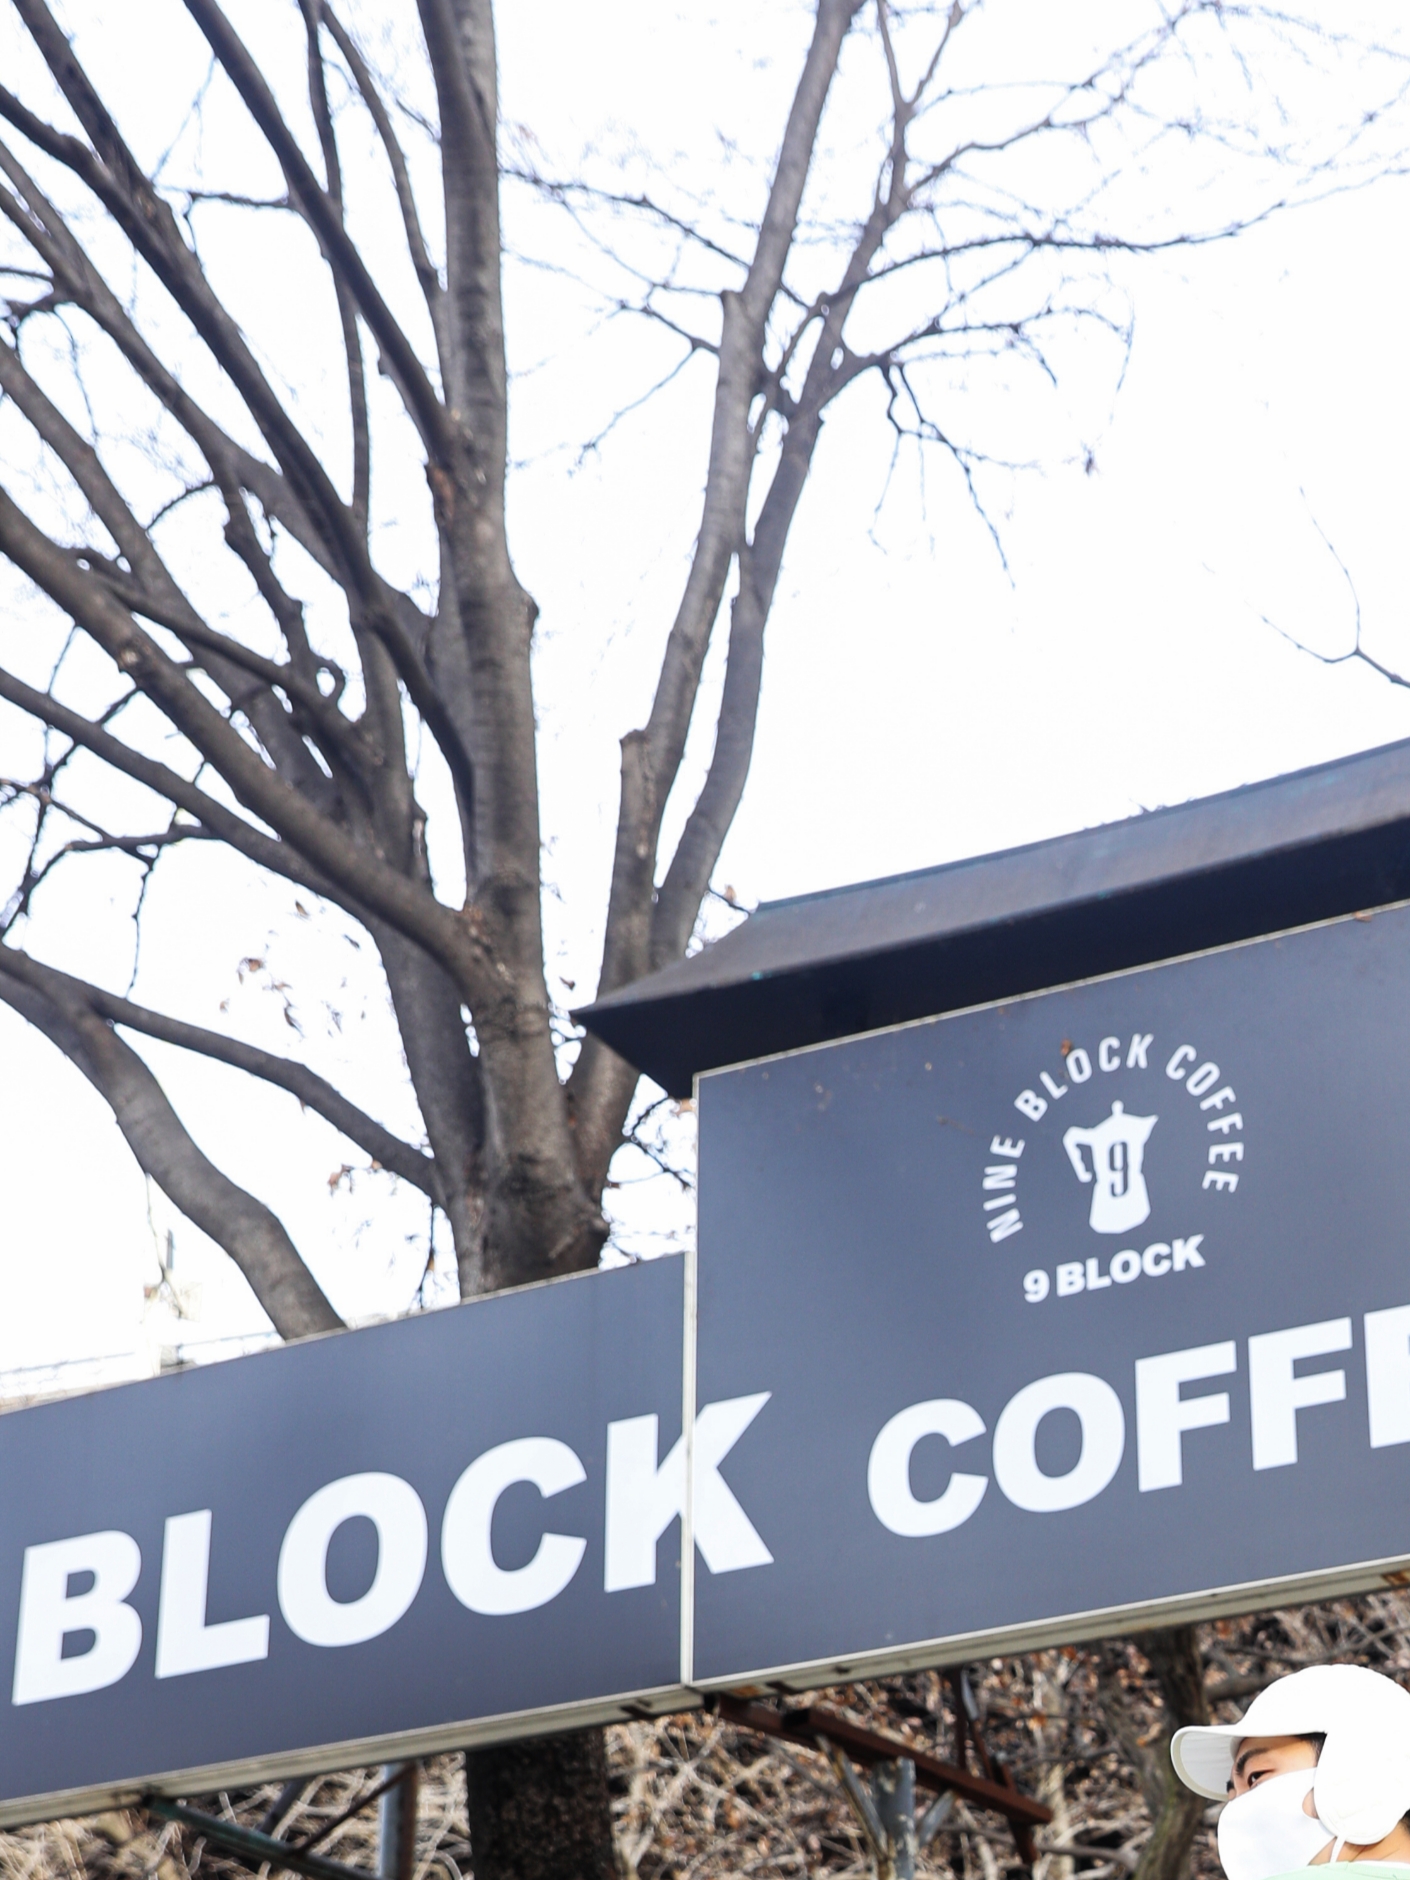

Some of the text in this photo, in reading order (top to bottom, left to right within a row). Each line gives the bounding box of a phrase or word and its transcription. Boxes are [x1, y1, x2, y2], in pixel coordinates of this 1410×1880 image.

[983, 1033, 1245, 1243] NINE BLOCK COFFEE
[1023, 1233, 1206, 1303] 9 BLOCK
[12, 1391, 775, 1706] BLOCK
